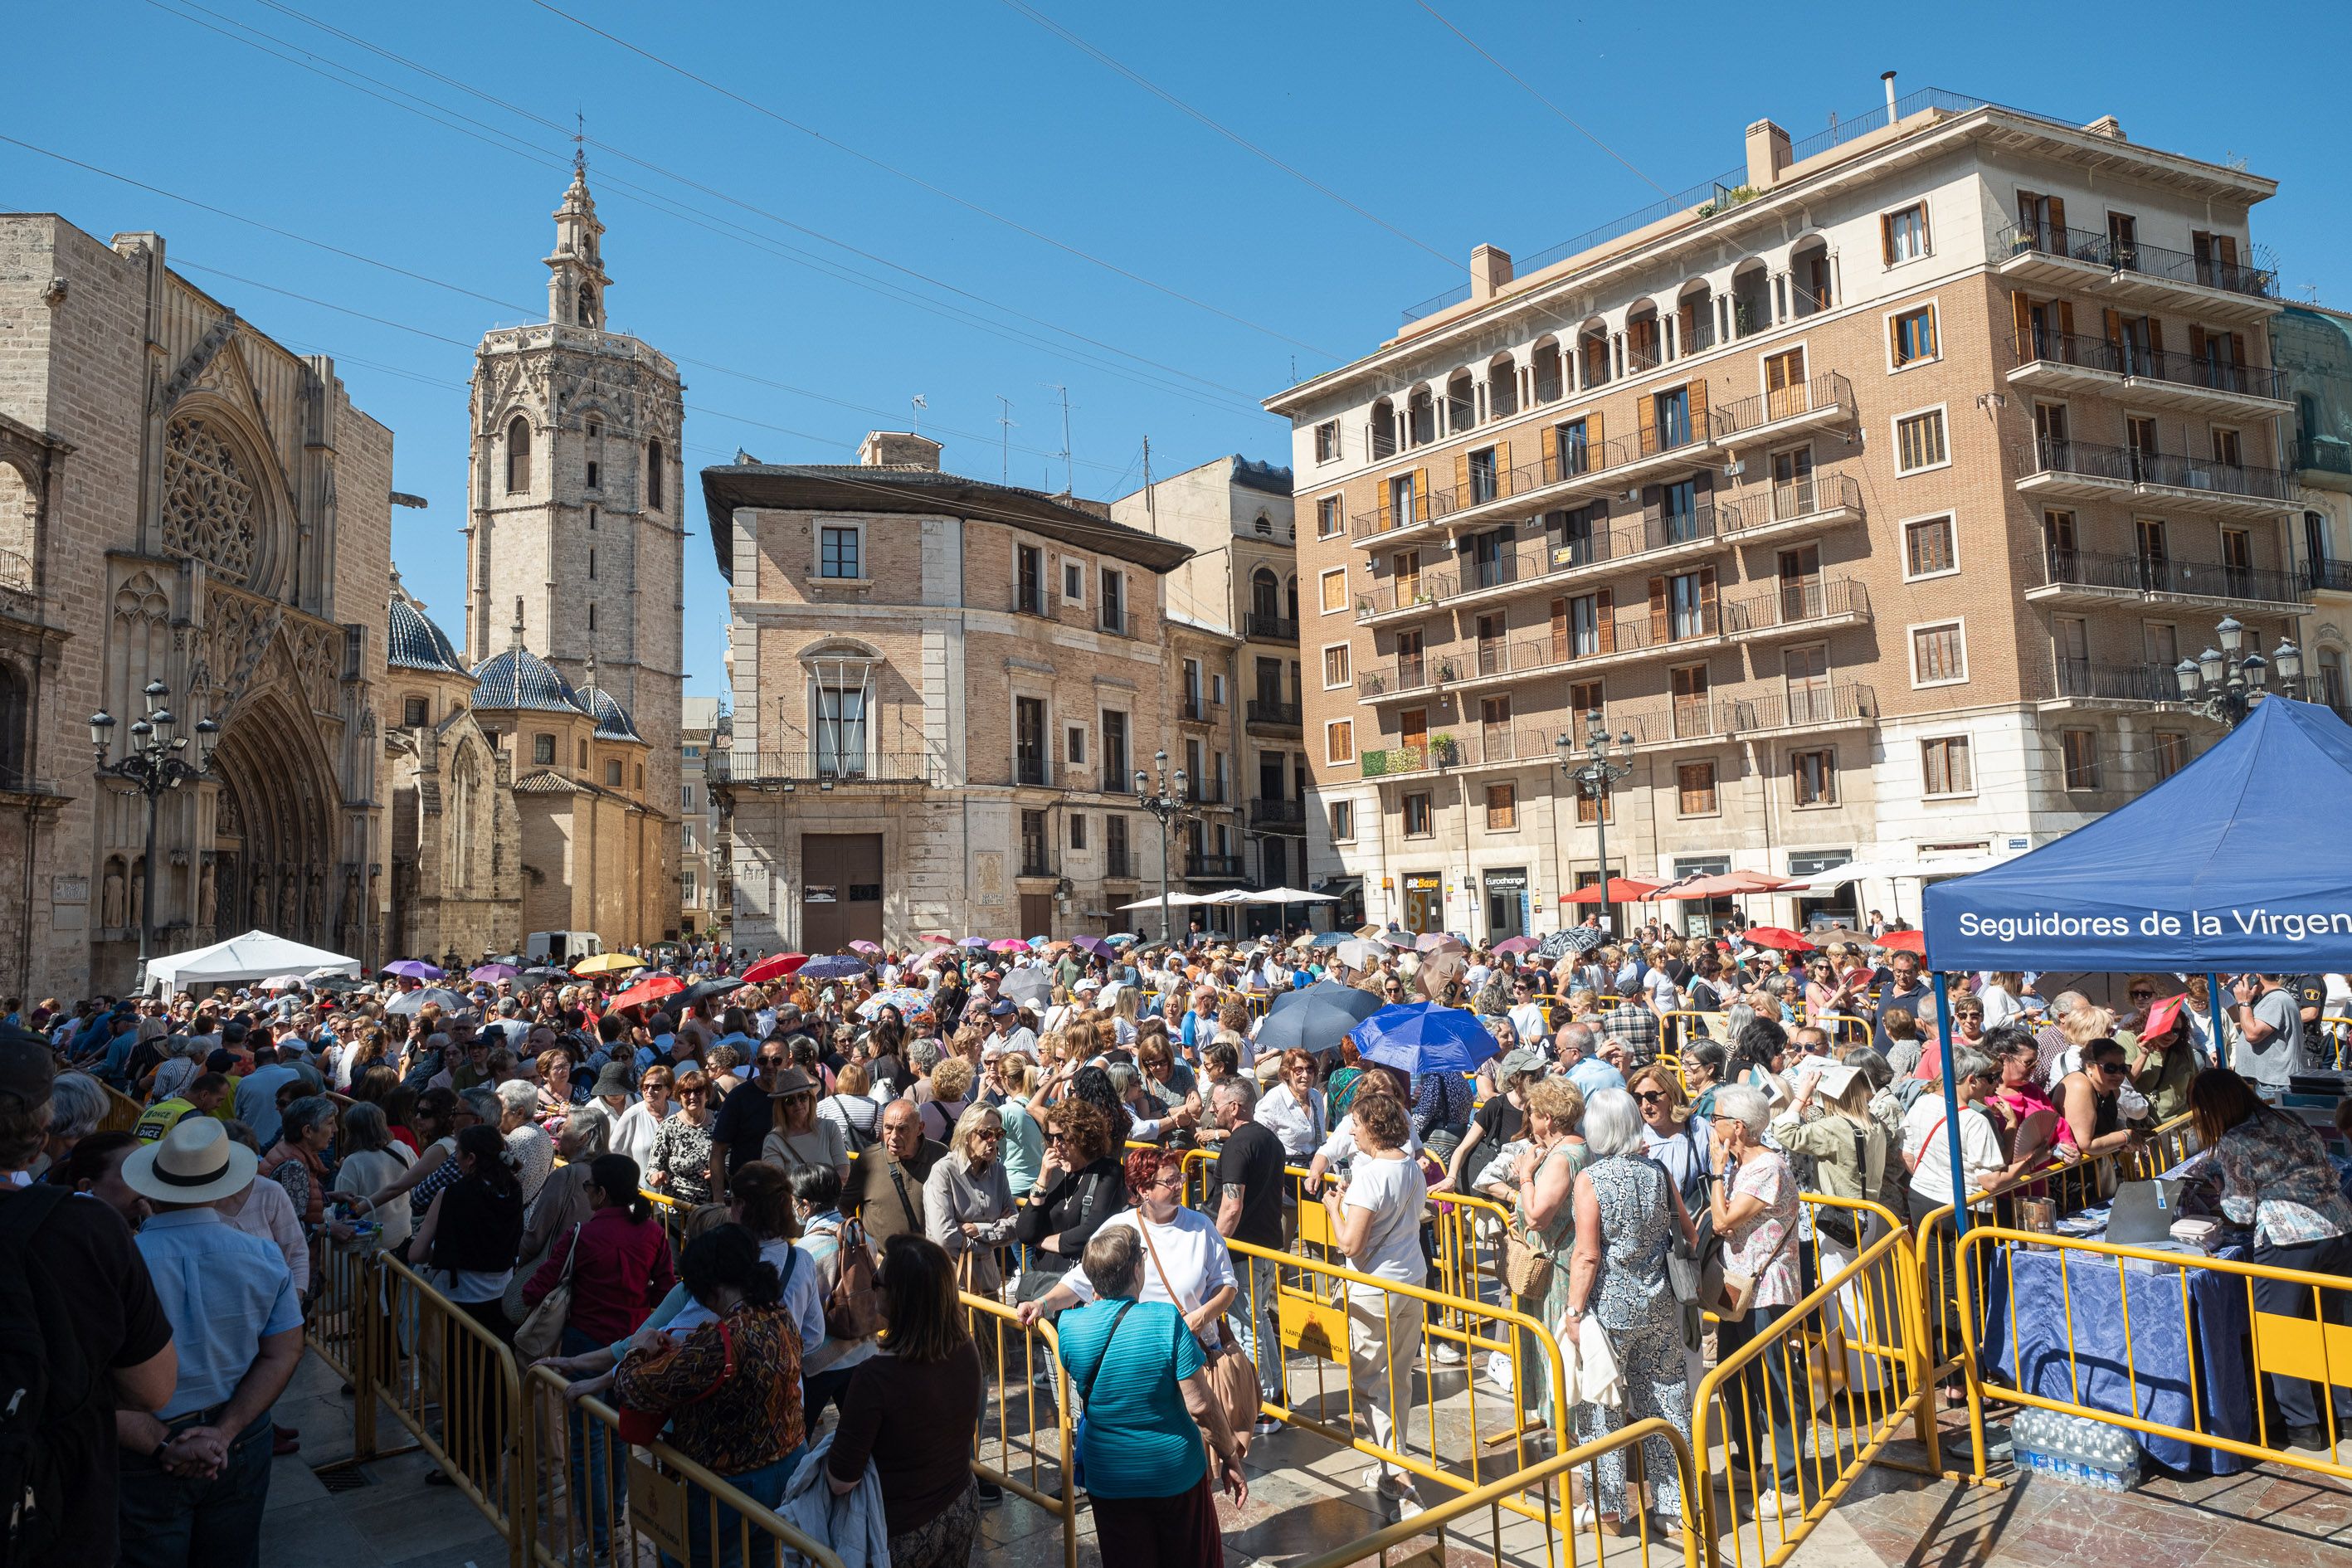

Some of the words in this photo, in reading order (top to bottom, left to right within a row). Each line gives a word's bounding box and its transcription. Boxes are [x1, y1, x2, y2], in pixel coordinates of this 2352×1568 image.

[1406, 878, 1439, 889] BitBase
[1485, 877, 1526, 885] Eurochange
[1960, 912, 2130, 942] Seguidores
[2140, 910, 2181, 936] de
[2193, 910, 2223, 936] la
[2232, 909, 2352, 942] Virgen
[139, 1129, 159, 1138] ONCE
[1313, 1337, 1320, 1346] DE
